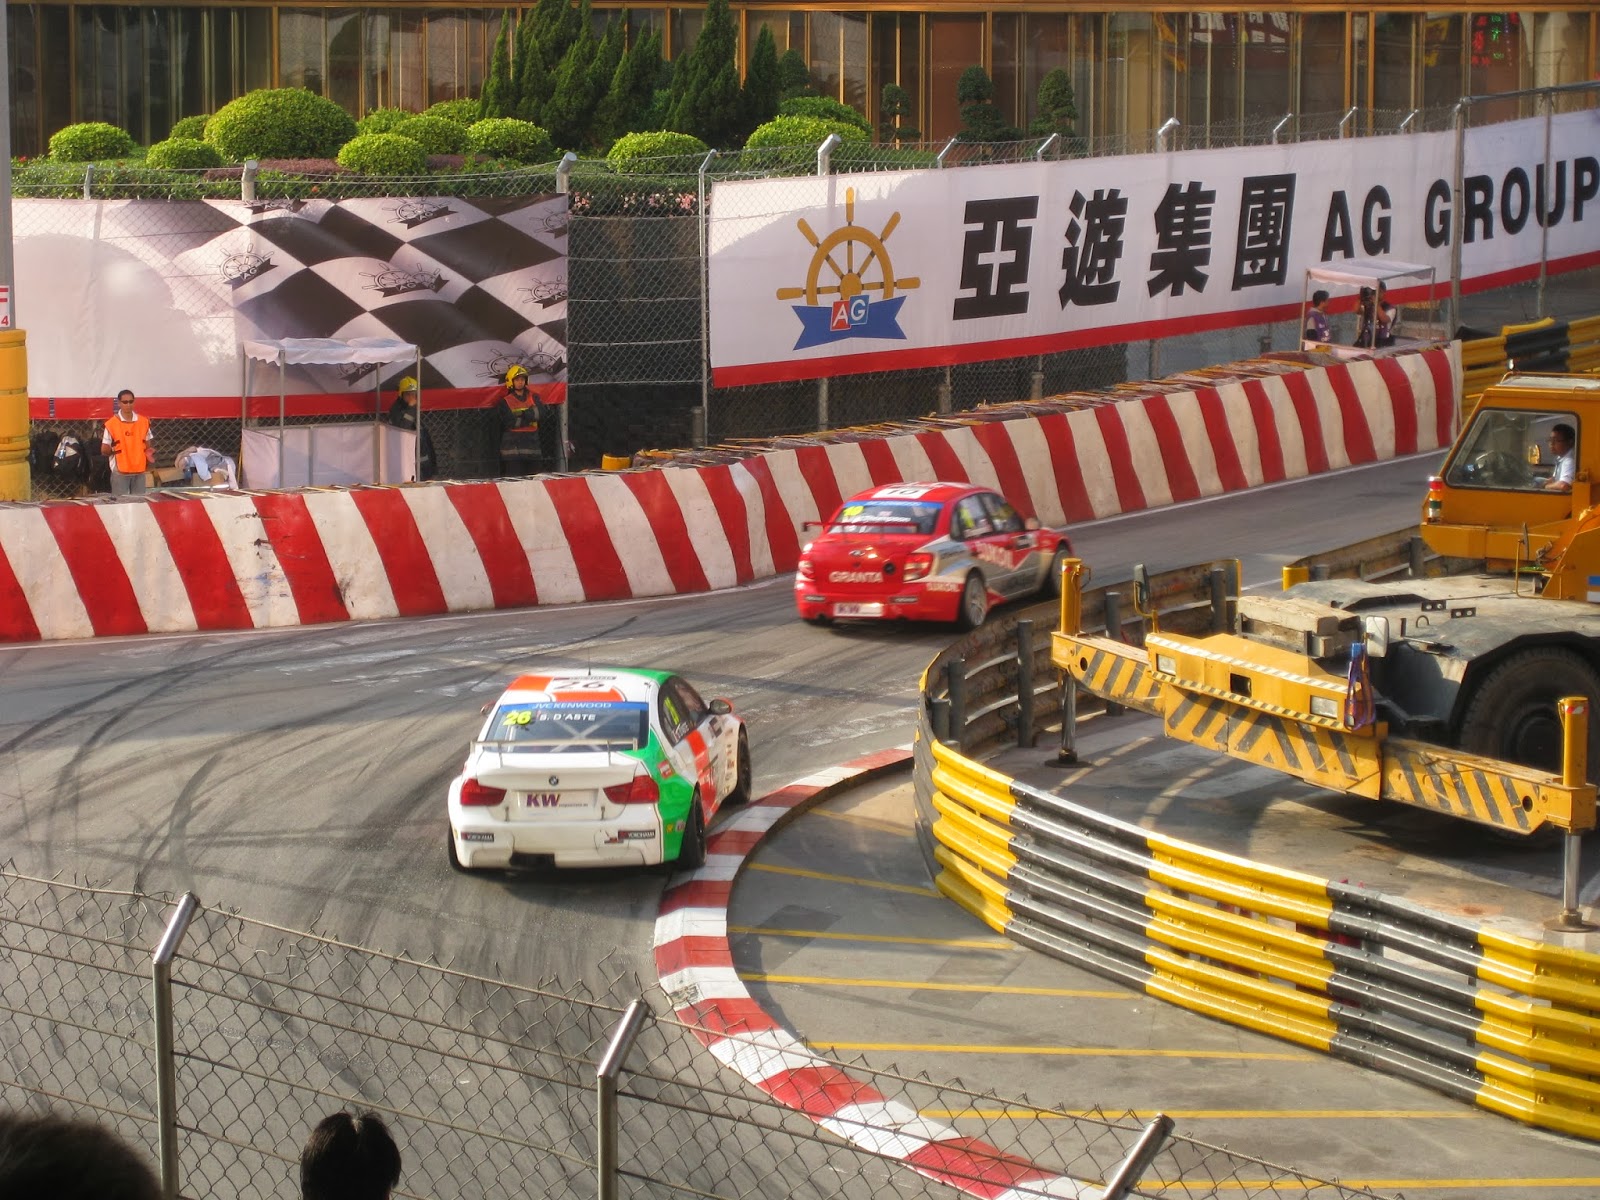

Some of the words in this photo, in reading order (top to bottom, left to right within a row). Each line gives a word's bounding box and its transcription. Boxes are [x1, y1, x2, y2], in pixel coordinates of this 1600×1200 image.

[953, 173, 1296, 320] 亞遊集團
[1321, 185, 1392, 262] AG
[1424, 156, 1600, 249] GROUP
[833, 299, 866, 327] AG
[828, 571, 884, 583] GRANTA
[553, 681, 605, 690] 26
[503, 710, 532, 726] 26
[526, 793, 560, 808] KW
